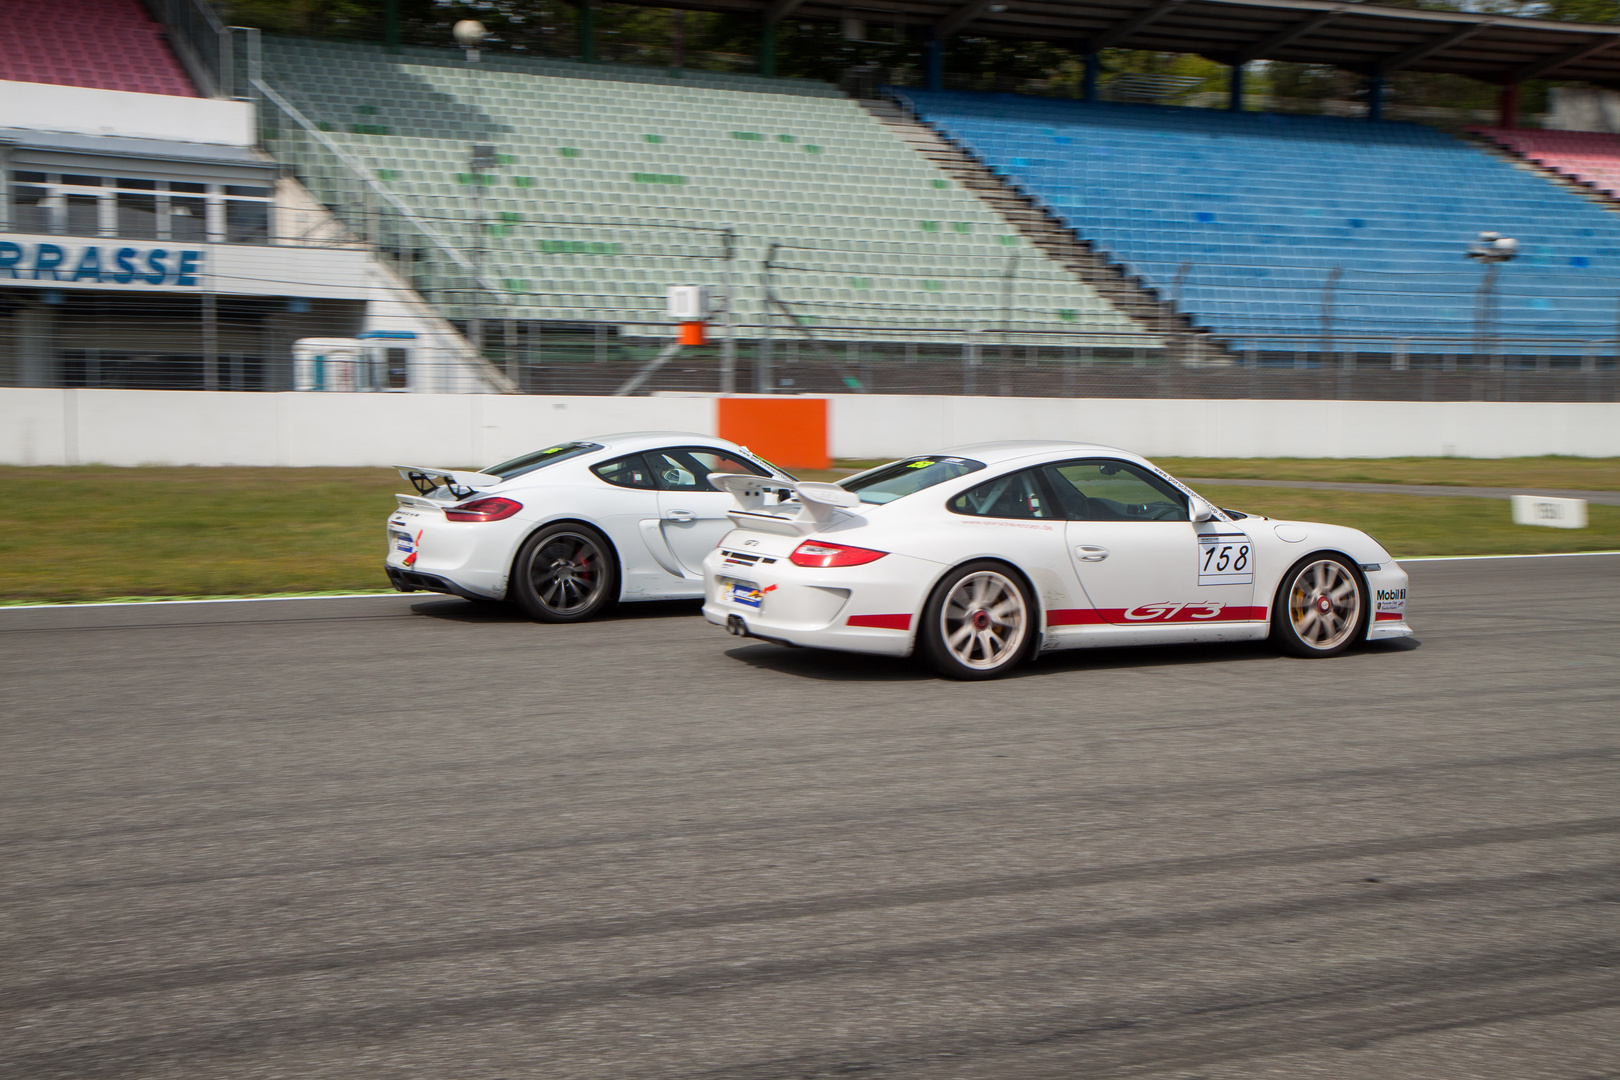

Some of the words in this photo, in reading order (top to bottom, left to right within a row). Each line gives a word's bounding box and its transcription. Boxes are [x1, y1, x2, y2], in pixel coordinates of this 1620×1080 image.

[1203, 545, 1249, 572] 158
[1377, 589, 1399, 600] Mobil
[1123, 600, 1227, 621] GT3
